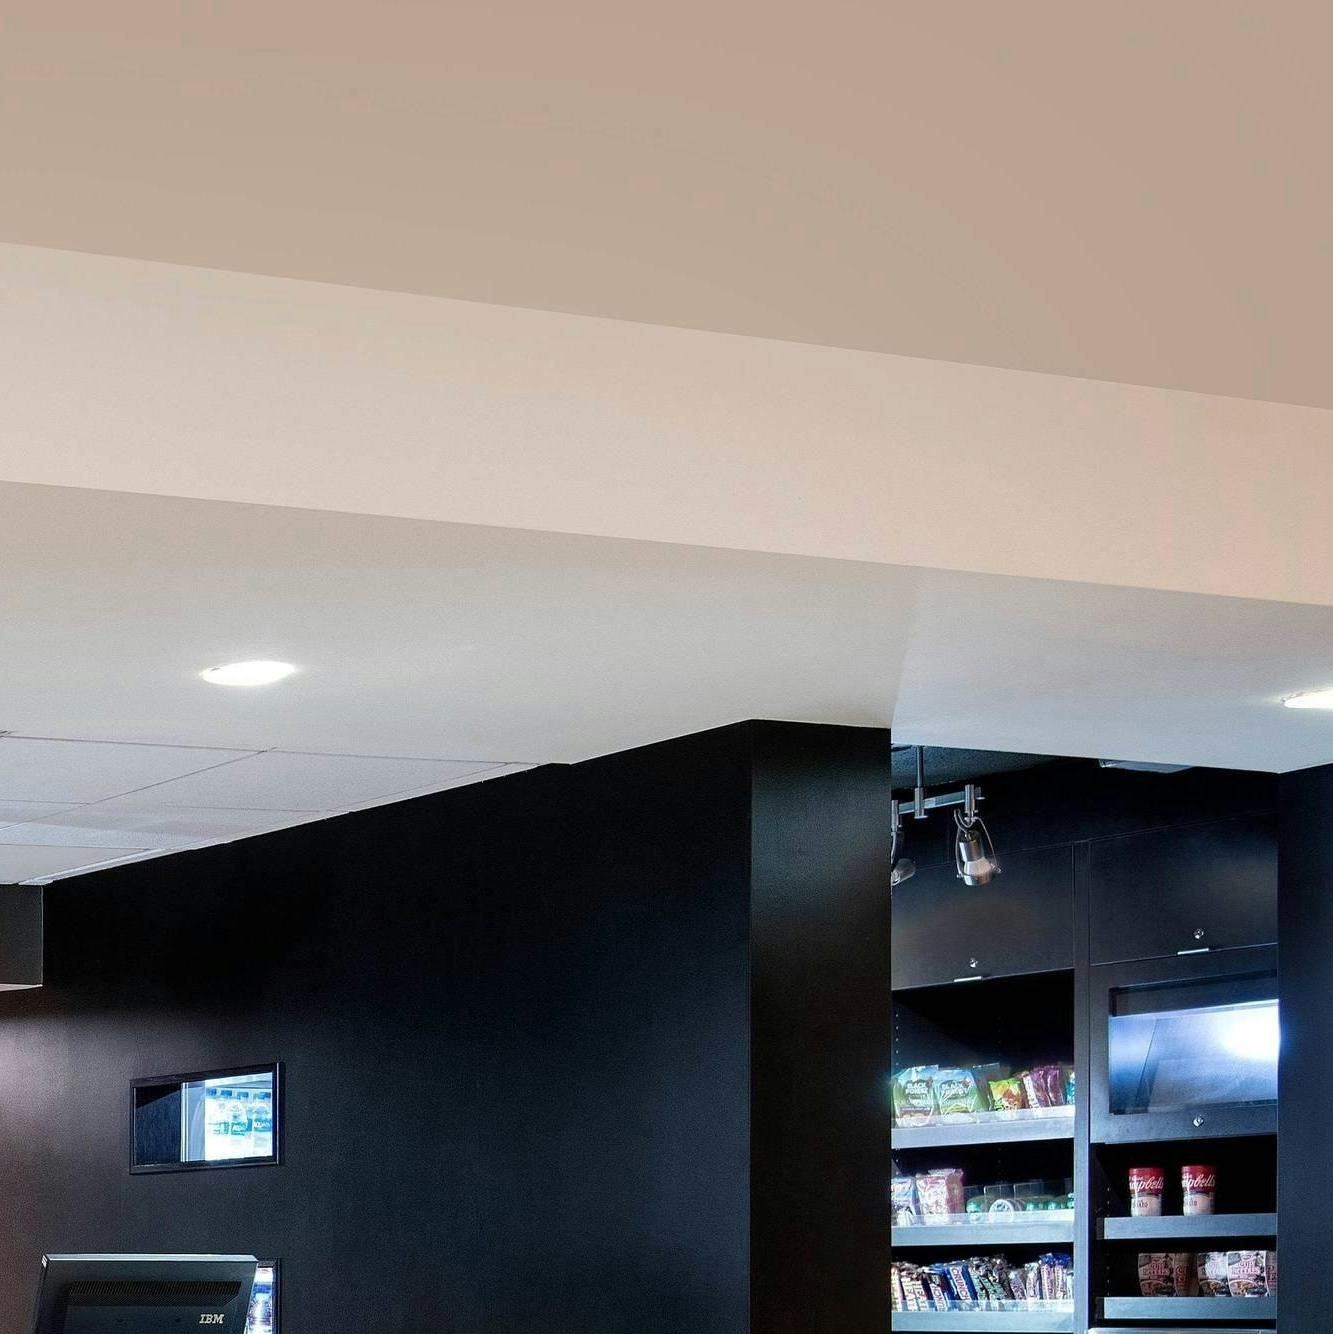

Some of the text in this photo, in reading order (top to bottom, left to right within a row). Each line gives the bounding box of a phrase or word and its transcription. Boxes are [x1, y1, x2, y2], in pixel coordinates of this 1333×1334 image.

[932, 1284, 947, 1312] RUNCH
[952, 1267, 971, 1301] CRUNCH
[199, 1314, 224, 1324] IBM
